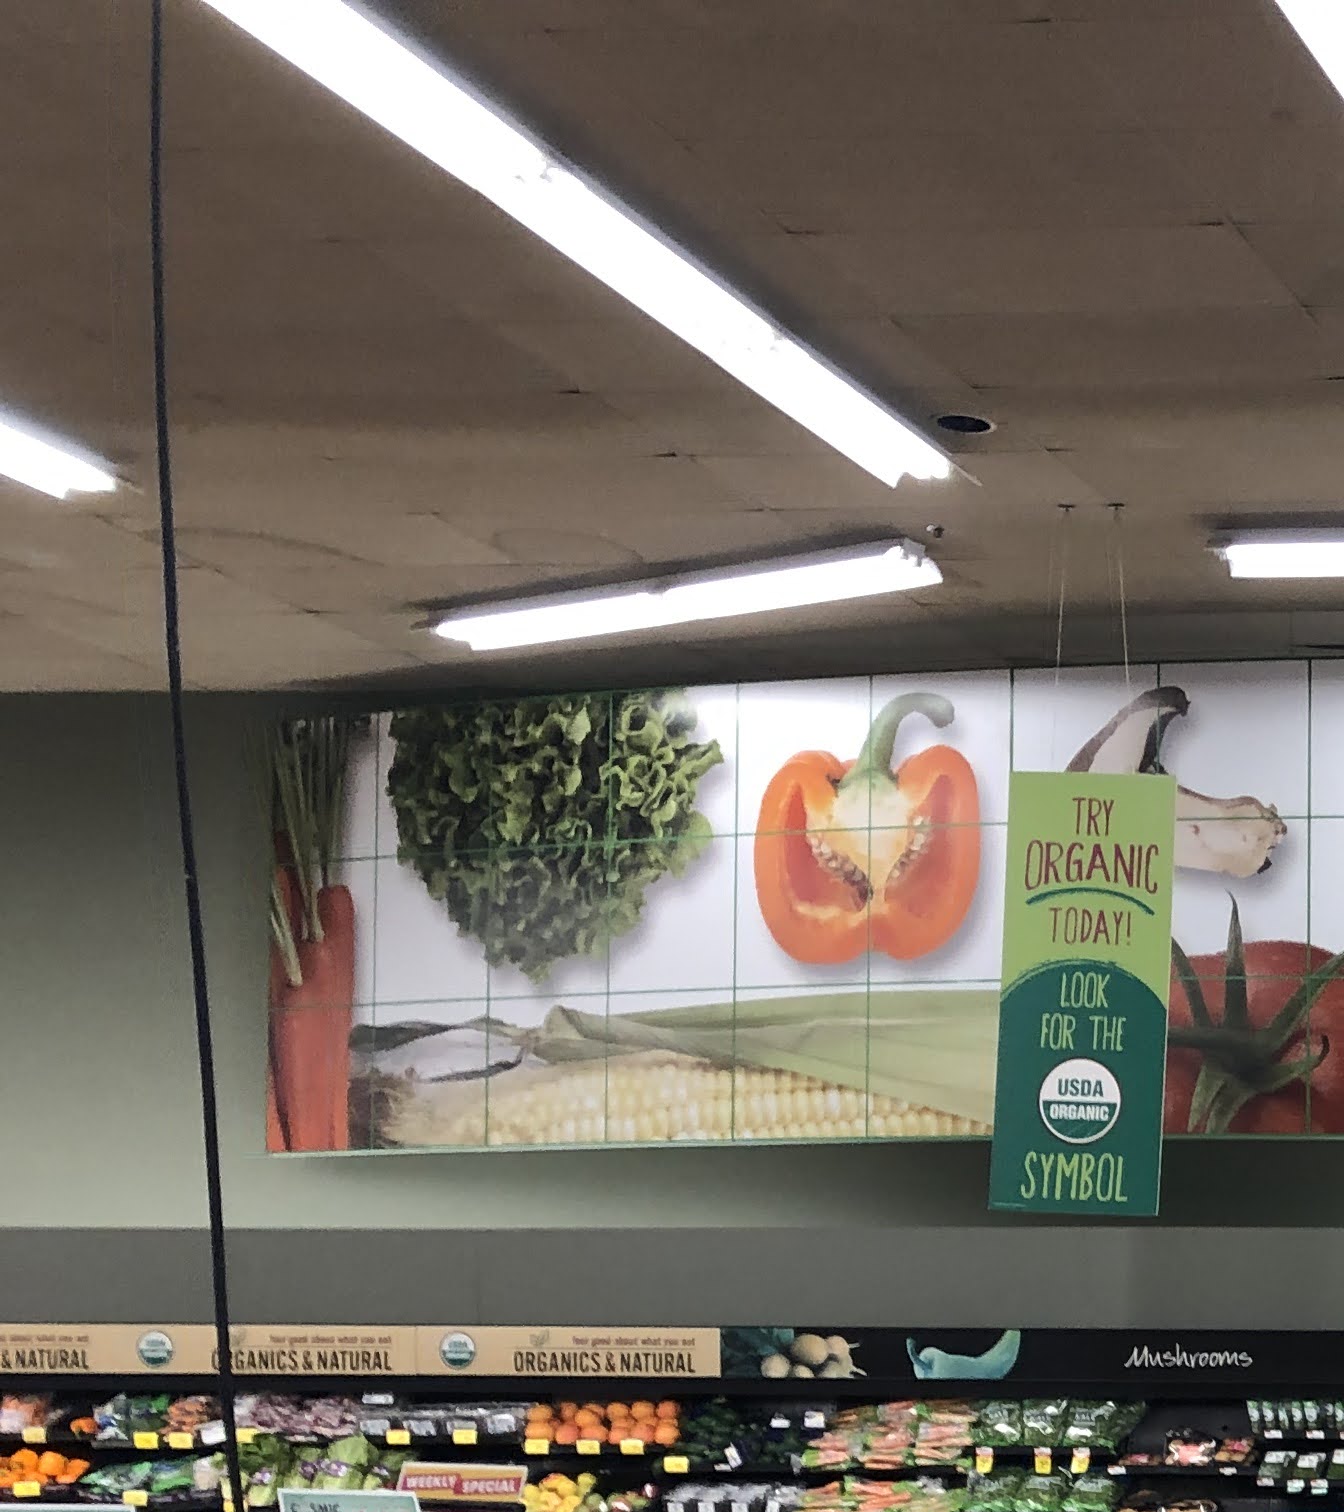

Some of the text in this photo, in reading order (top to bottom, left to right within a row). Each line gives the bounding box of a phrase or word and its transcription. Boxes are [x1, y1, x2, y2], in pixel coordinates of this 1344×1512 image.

[1071, 797, 1115, 838] TRY
[1024, 839, 1160, 894] ORGANIC
[1048, 906, 1132, 947] TODAY!
[1060, 972, 1110, 1009] LOOK
[1040, 1013, 1127, 1052] FOR THE
[1057, 1078, 1104, 1099] USDA
[1049, 1104, 1110, 1123] ORGANIC
[1021, 1151, 1128, 1203] SYMBOL
[1, 1349, 89, 1370] & NATURAL
[211, 1350, 392, 1371] OGANICS & NATURAL
[513, 1351, 696, 1373] ORGANICS & NATURAL
[1123, 1343, 1253, 1368] Mushrooms
[406, 1474, 516, 1494] WEEKLY SPECIAL
